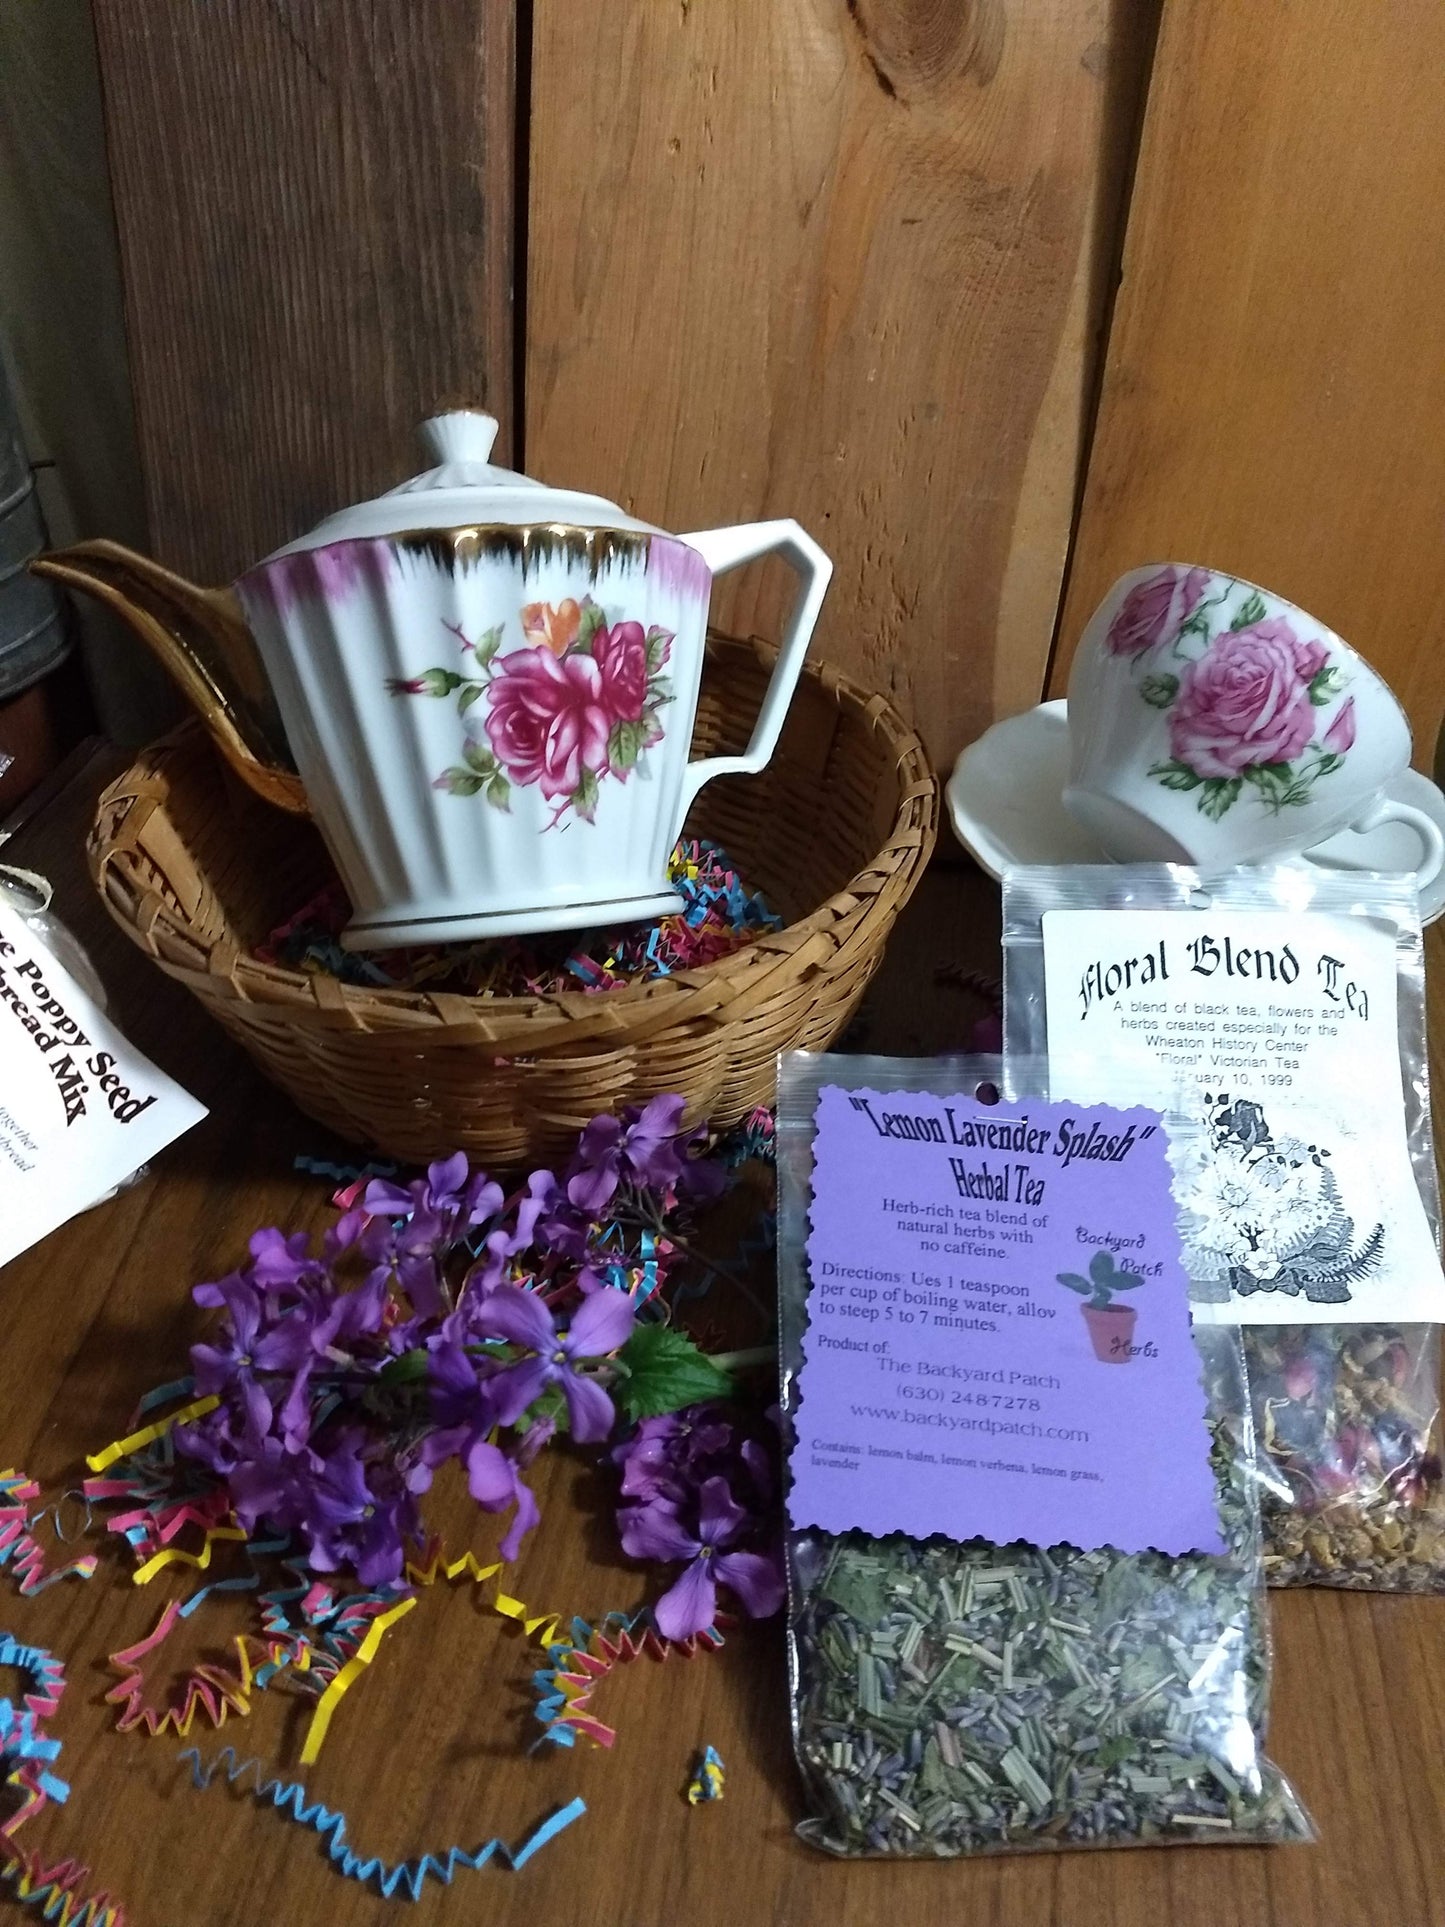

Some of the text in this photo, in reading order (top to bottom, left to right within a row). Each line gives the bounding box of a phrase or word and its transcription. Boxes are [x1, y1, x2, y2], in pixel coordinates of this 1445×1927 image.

[1079, 935, 1369, 1021] Floral Blend Tea
[1113, 1001, 1346, 1019] A blend of black tea, flowers and
[1121, 1017, 1339, 1036] herbs created especially for the
[13, 959, 92, 1049] Poppy
[86, 1051, 158, 1123] Seed
[1145, 1035, 1310, 1053] Wheaton History Center
[1210, 1054, 1268, 1069] Victorian
[1275, 1057, 1301, 1069] Tea
[48, 1053, 89, 1127] Mix
[1233, 1073, 1253, 1086] 10,
[1261, 1074, 1293, 1086] 1999
[944, 1107, 1051, 1154] Lavender
[1053, 1117, 1157, 1168] Splash"
[949, 1157, 1046, 1207] Herbal Tea
[882, 1198, 1049, 1229] Herb-rich tea blend of
[897, 1219, 1034, 1244] natural herbs with
[1075, 1226, 1146, 1252] Backyard
[920, 1240, 1010, 1260] no caffeine.
[822, 1262, 1030, 1298] Directions: Ues 1 teaspoon
[1120, 1257, 1164, 1277] Patch
[820, 1283, 846, 1298] per
[850, 1288, 878, 1302] cup
[882, 1288, 901, 1302] of
[903, 1291, 958, 1312] boiling
[964, 1299, 1012, 1317] water,
[819, 1301, 1001, 1334] to steep 5 to 7 minutes.
[817, 1334, 891, 1354] Product of:
[1109, 1336, 1159, 1358] Herbs
[877, 1357, 1061, 1389] The Backyard Patch
[896, 1384, 945, 1402] (630)
[850, 1404, 1090, 1443] www.backyardpatch.com
[811, 1454, 861, 1472] lavender
[868, 1444, 903, 1459] lemon
[906, 1448, 938, 1464] balm,
[941, 1453, 977, 1468] lemon
[1031, 1463, 1067, 1478] lemon
